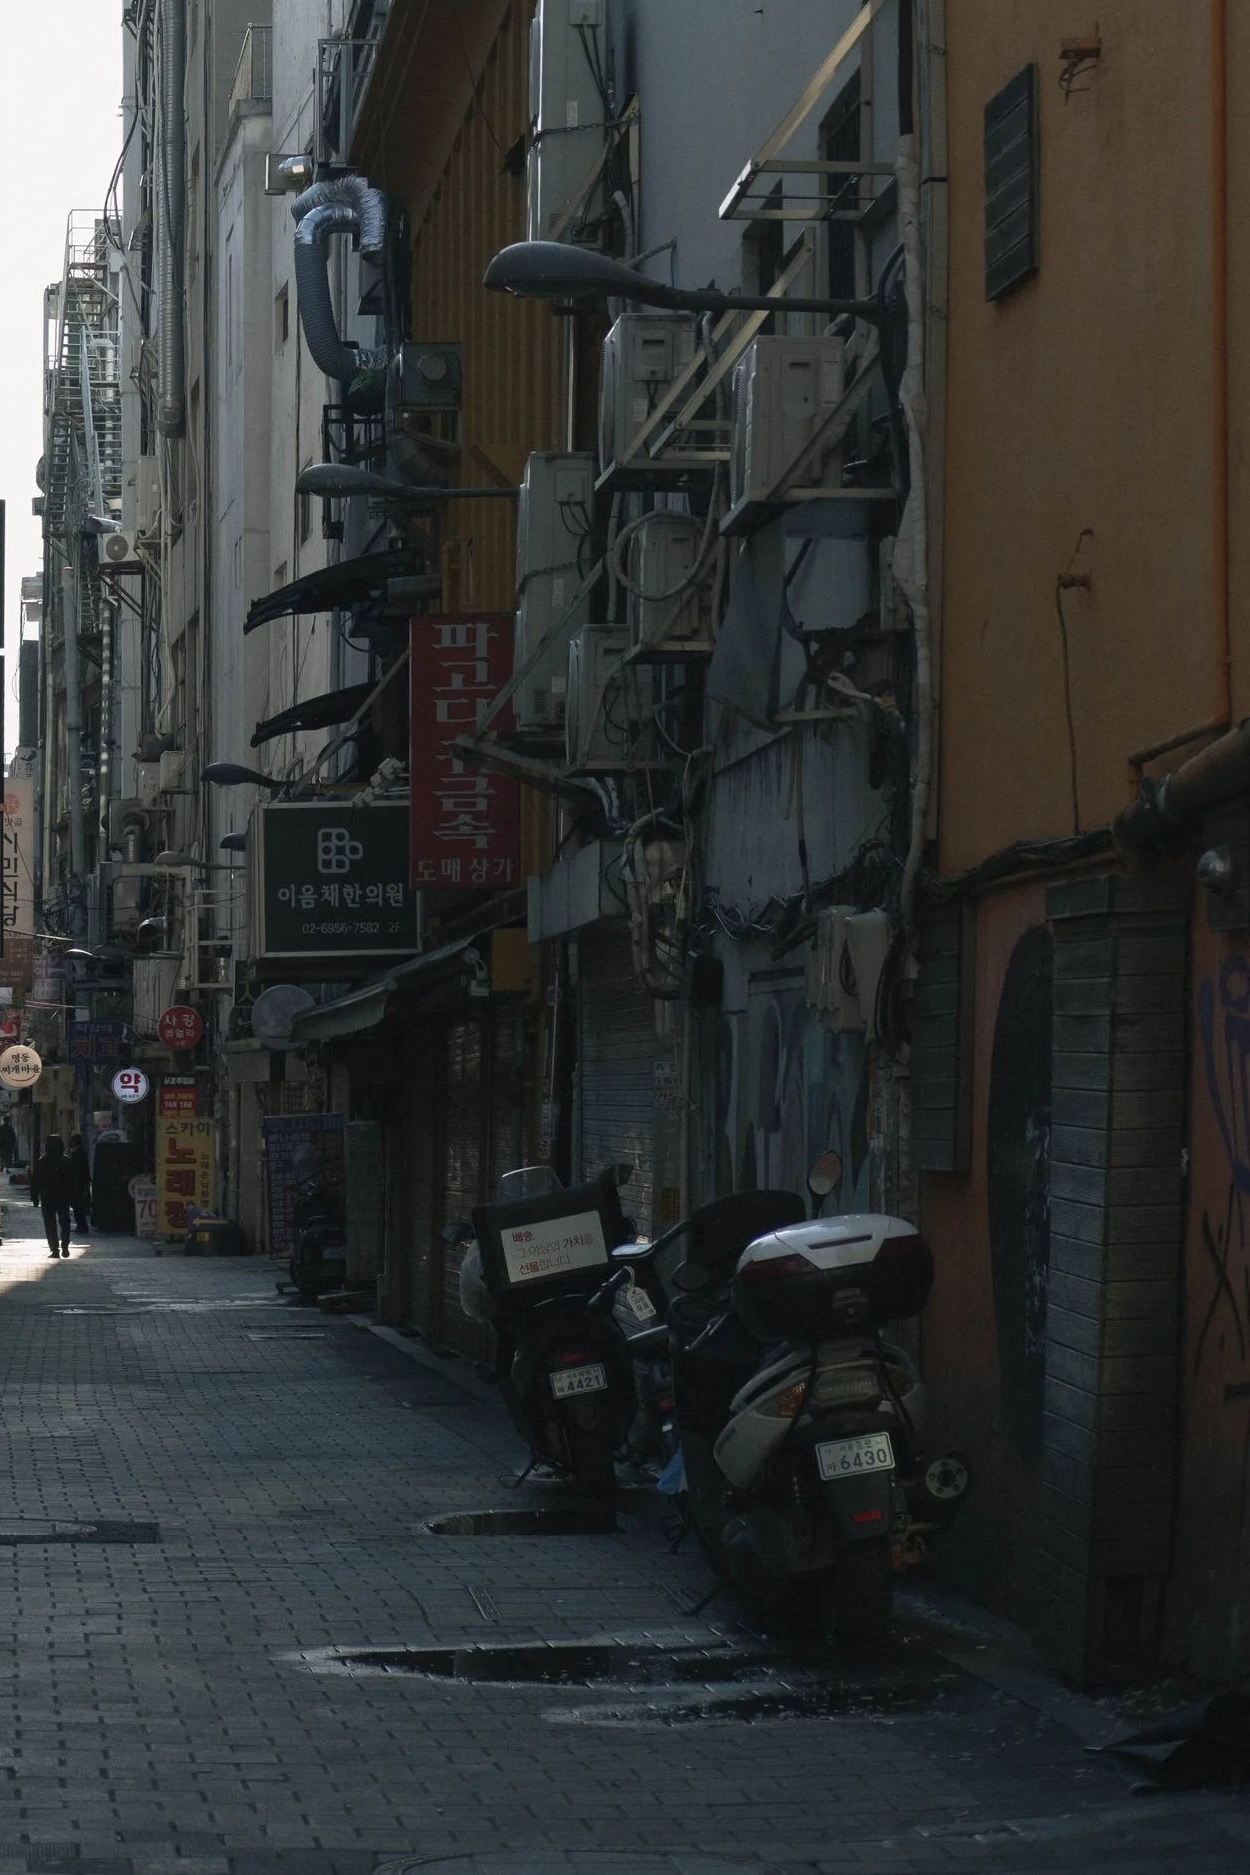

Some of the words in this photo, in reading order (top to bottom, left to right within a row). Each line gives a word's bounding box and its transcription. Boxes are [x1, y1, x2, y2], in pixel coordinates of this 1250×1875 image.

[416, 857, 515, 884] 도매상가
[277, 881, 405, 910] 이음채한의원
[301, 921, 381, 935] 02-6956-7582
[11, 1052, 31, 1063] 명동
[120, 1073, 141, 1094] 약
[165, 1122, 211, 1137] 스카이
[528, 1240, 561, 1256] 이상의
[567, 1375, 601, 1392] 4421
[841, 1448, 887, 1470] 6430
